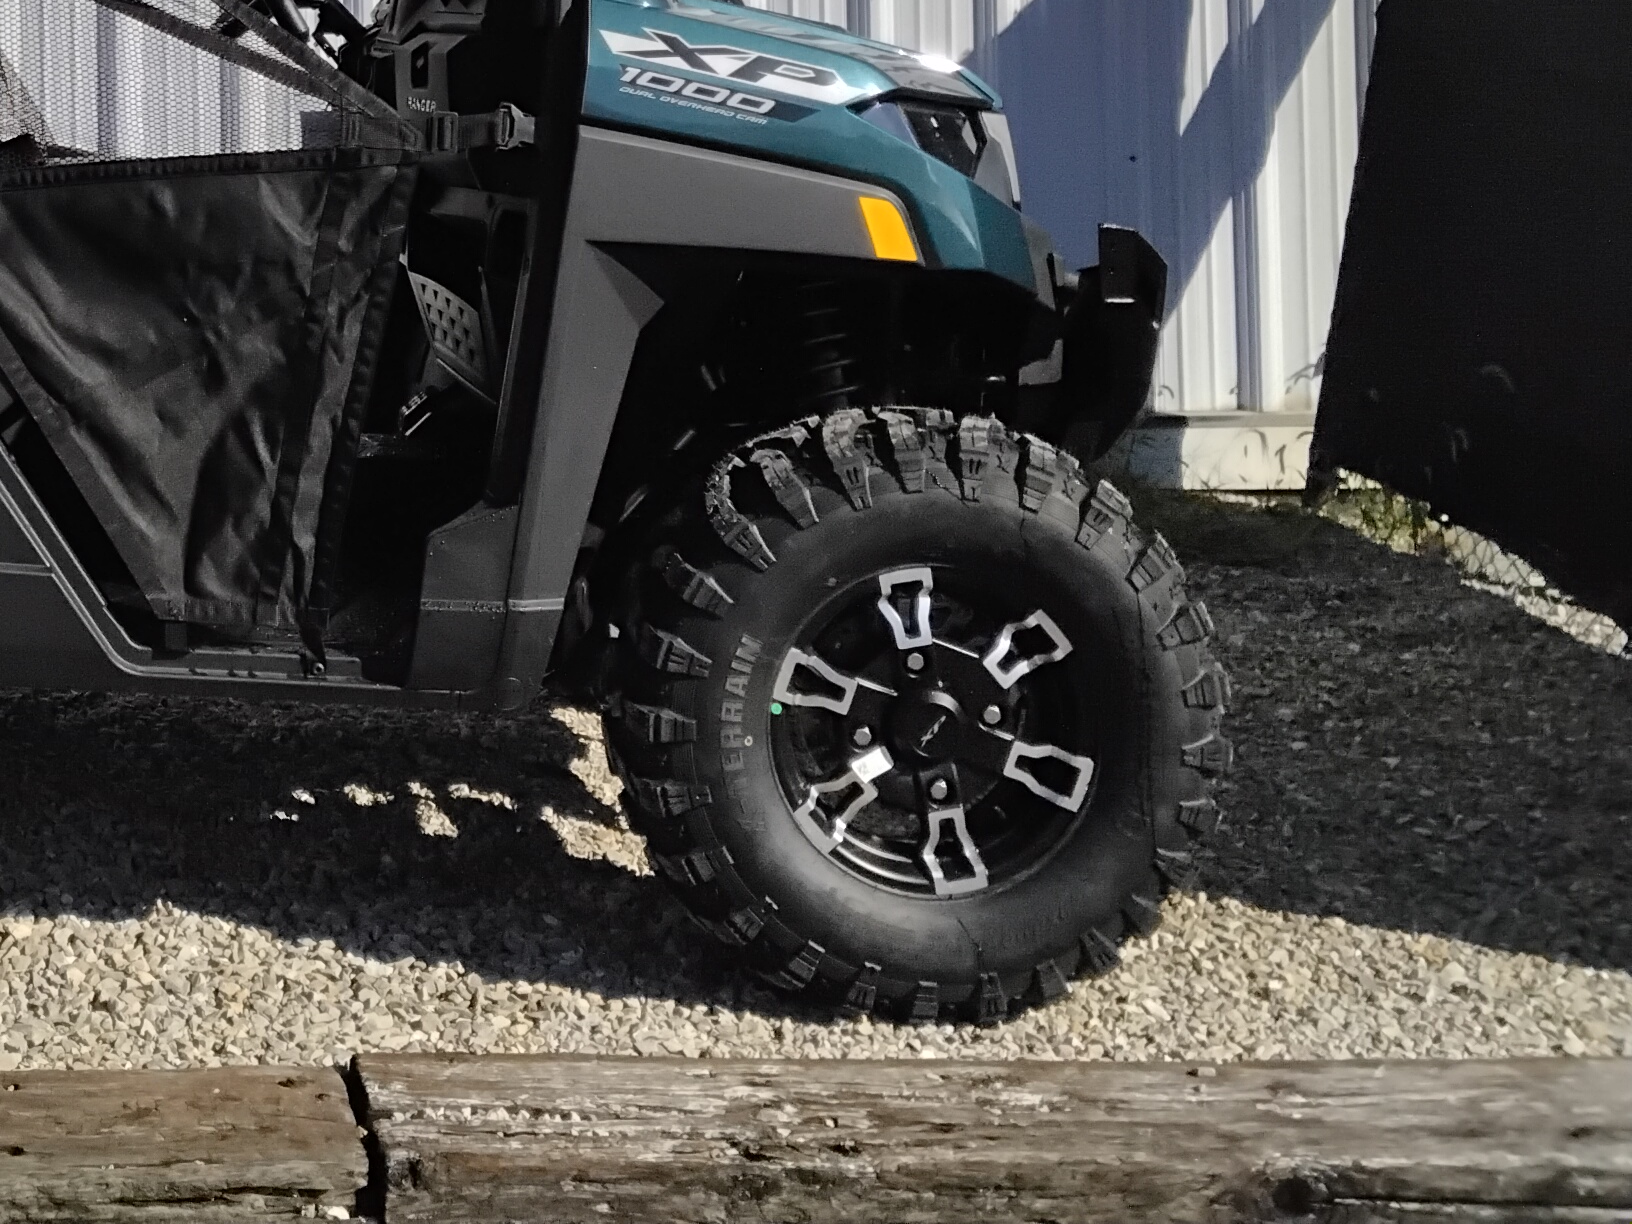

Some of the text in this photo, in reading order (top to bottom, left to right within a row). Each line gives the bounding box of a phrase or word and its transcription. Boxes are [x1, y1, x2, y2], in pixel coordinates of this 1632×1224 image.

[615, 26, 840, 86] XP
[619, 66, 776, 114] 1000
[619, 85, 657, 100] DUAL
[659, 95, 734, 117] OVERHEAD
